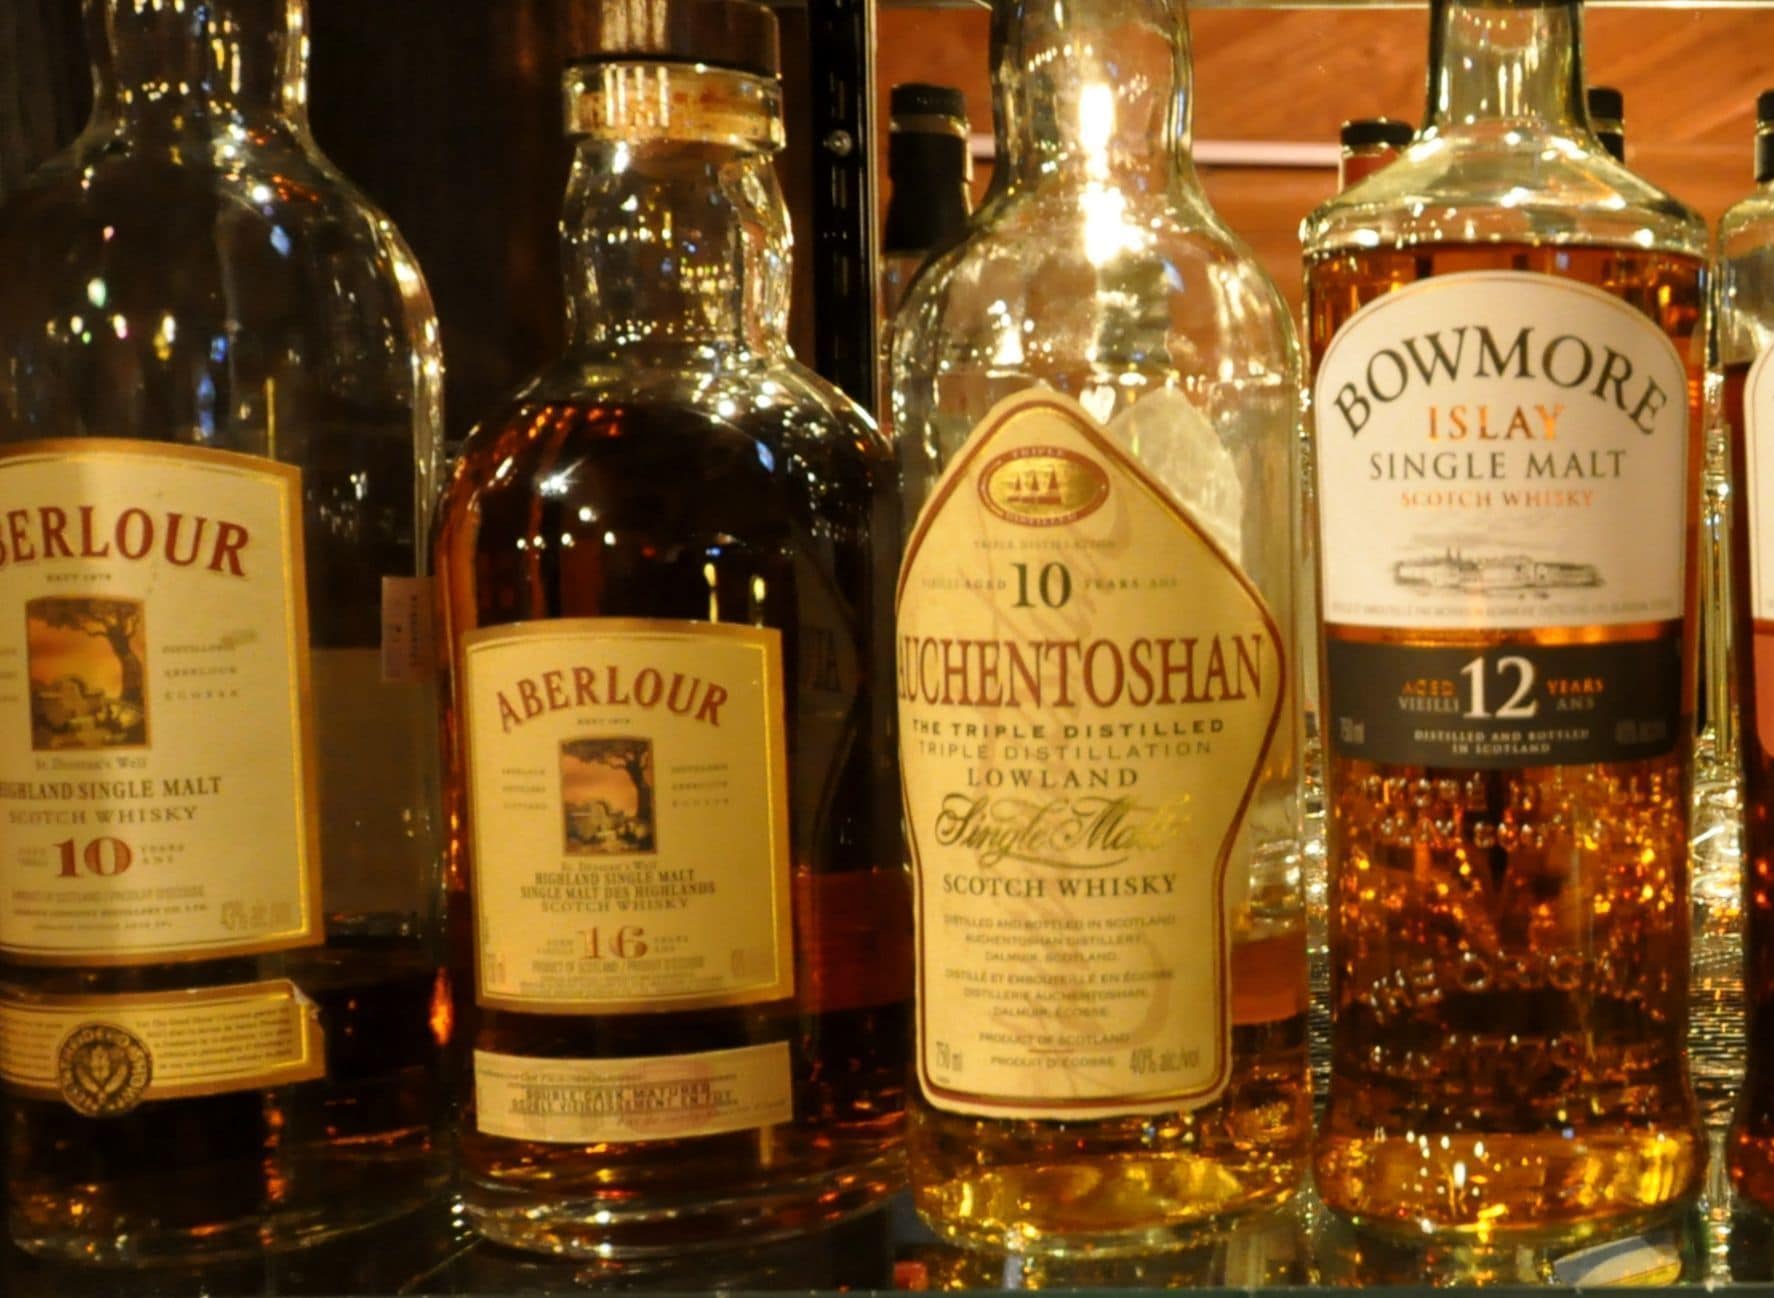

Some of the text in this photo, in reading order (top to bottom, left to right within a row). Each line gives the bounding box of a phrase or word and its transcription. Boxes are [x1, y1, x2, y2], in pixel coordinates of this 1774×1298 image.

[1333, 325, 1667, 438] BOWMORE
[1427, 405, 1564, 442] ISLAY
[1369, 450, 1628, 481] SINGLE MALT
[1401, 490, 1594, 508] SCOTCH WHISKY
[0, 505, 250, 578] ERLOUR
[1008, 561, 1072, 609] 10
[496, 665, 729, 734] ABERLOUR
[1401, 680, 1457, 698] AGED
[1459, 655, 1538, 720] 12
[1546, 678, 1605, 696] YEARS
[912, 718, 1225, 740] THE TRIPLE DISTILLED
[919, 739, 1212, 761] TRIPLE DISTILLATION
[78, 779, 153, 801] SINGLE
[162, 776, 222, 798] MALT
[966, 767, 1139, 789] LOWLAND
[9, 805, 199, 825] SCOTCH WHISKY
[934, 792, 1060, 868] Single
[52, 835, 133, 879] 10
[535, 868, 695, 886] HIGHLAND SINGLE MALT
[942, 873, 1178, 897] SCOTCH WHISKY
[541, 897, 689, 913] SCOTCH WHISKY
[576, 925, 649, 961] 16
